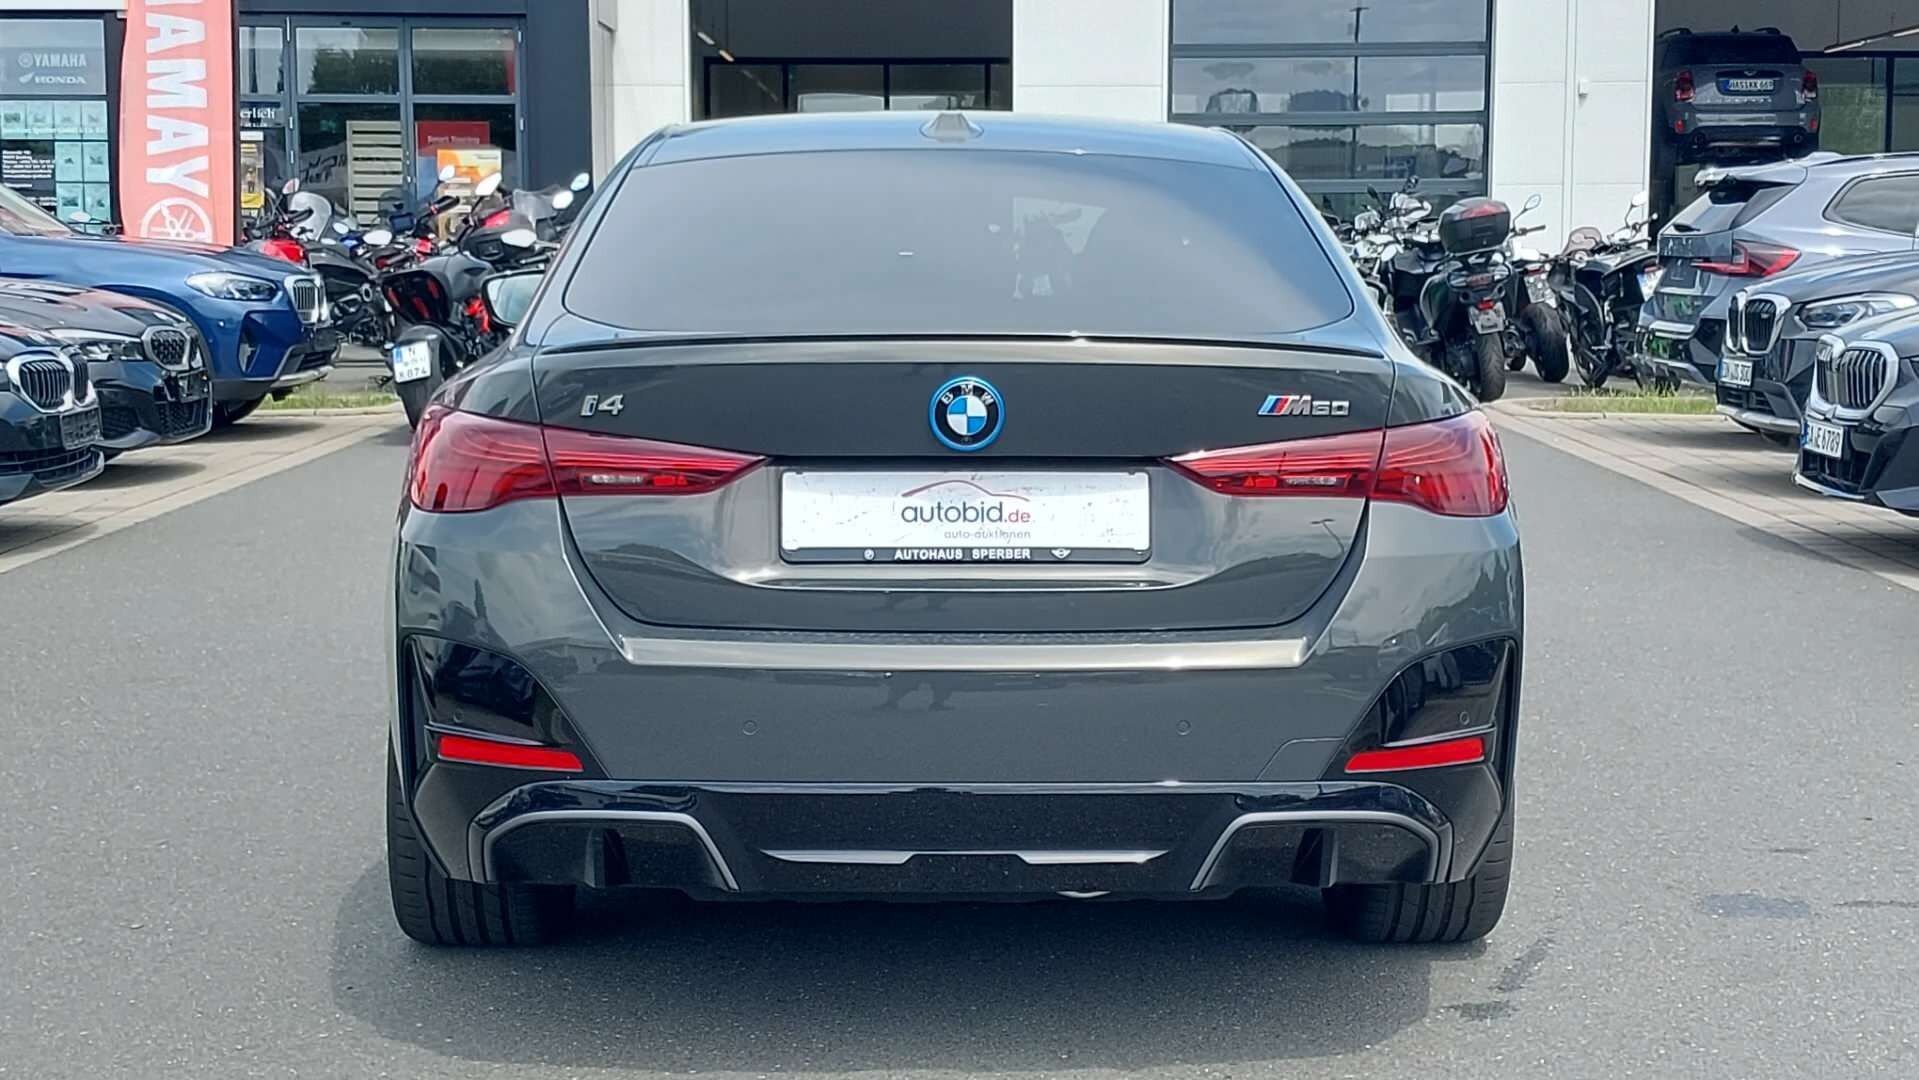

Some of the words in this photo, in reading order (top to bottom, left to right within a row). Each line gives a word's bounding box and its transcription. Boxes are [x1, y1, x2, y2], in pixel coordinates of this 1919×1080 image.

[33, 53, 88, 68] YAMAHA
[34, 75, 87, 85] HONDA
[144, 0, 209, 199] YAMA
[941, 384, 994, 404] BMW
[901, 501, 1031, 523] autobid.de
[944, 528, 1031, 540] auto-auktionen
[894, 548, 963, 560] AUTOHAUS
[972, 548, 1031, 560] SPERBER
